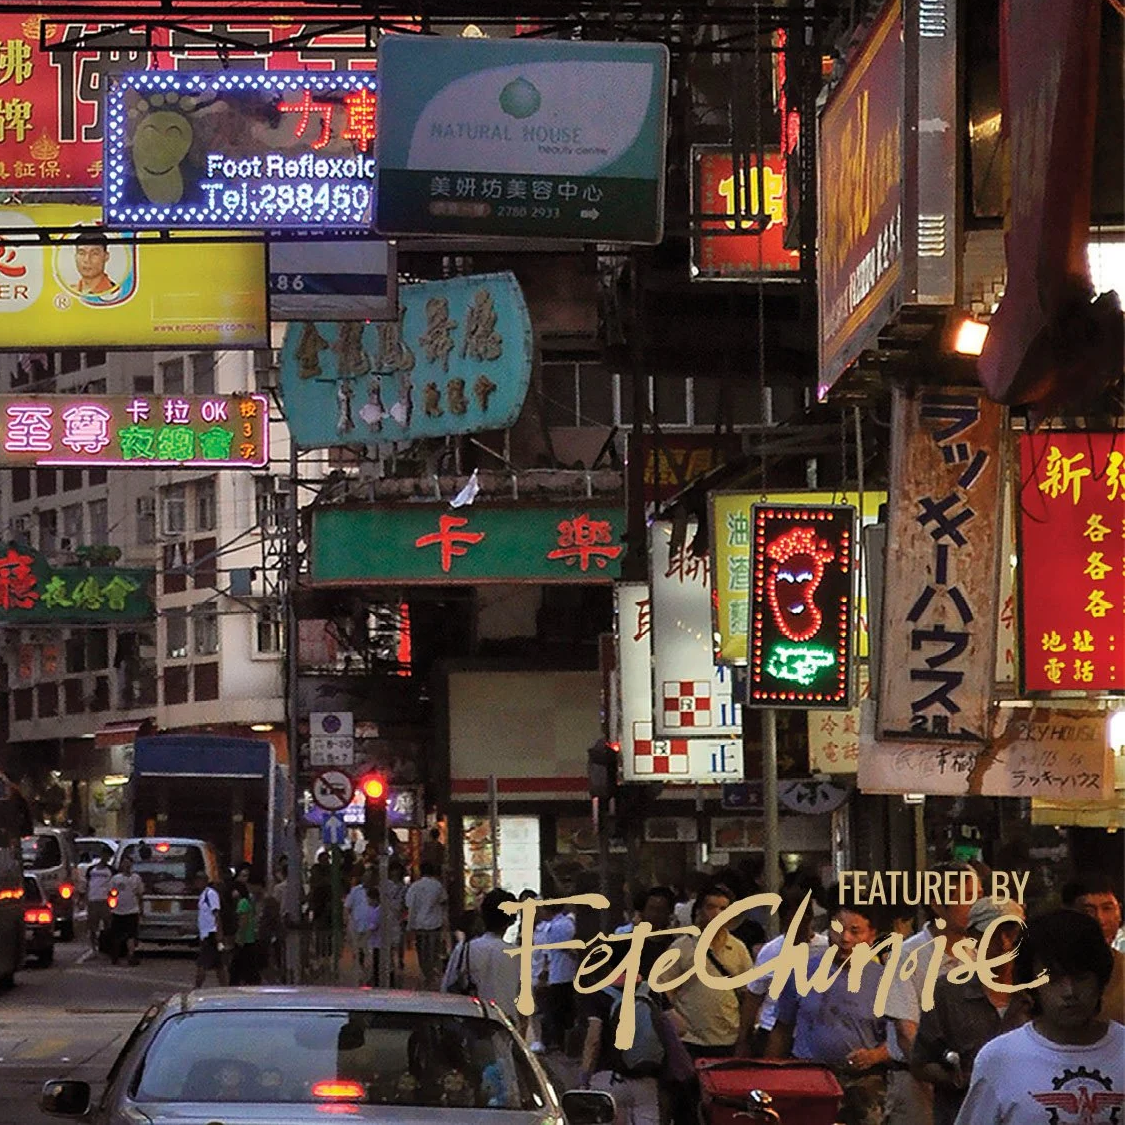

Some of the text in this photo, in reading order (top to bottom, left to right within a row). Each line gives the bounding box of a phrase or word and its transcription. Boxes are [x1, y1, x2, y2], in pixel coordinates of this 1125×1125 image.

[430, 123, 583, 145] NATURAL HOUSE
[538, 144, 573, 156] beauty
[207, 154, 262, 179] Foot
[270, 274, 305, 291] 86
[126, 400, 228, 425] 卡拉OK
[4, 405, 111, 453] 至尊
[119, 425, 234, 462] 夜總會
[906, 394, 990, 715] ラッキーハウス
[1012, 770, 1101, 789] ラッキーハウス
